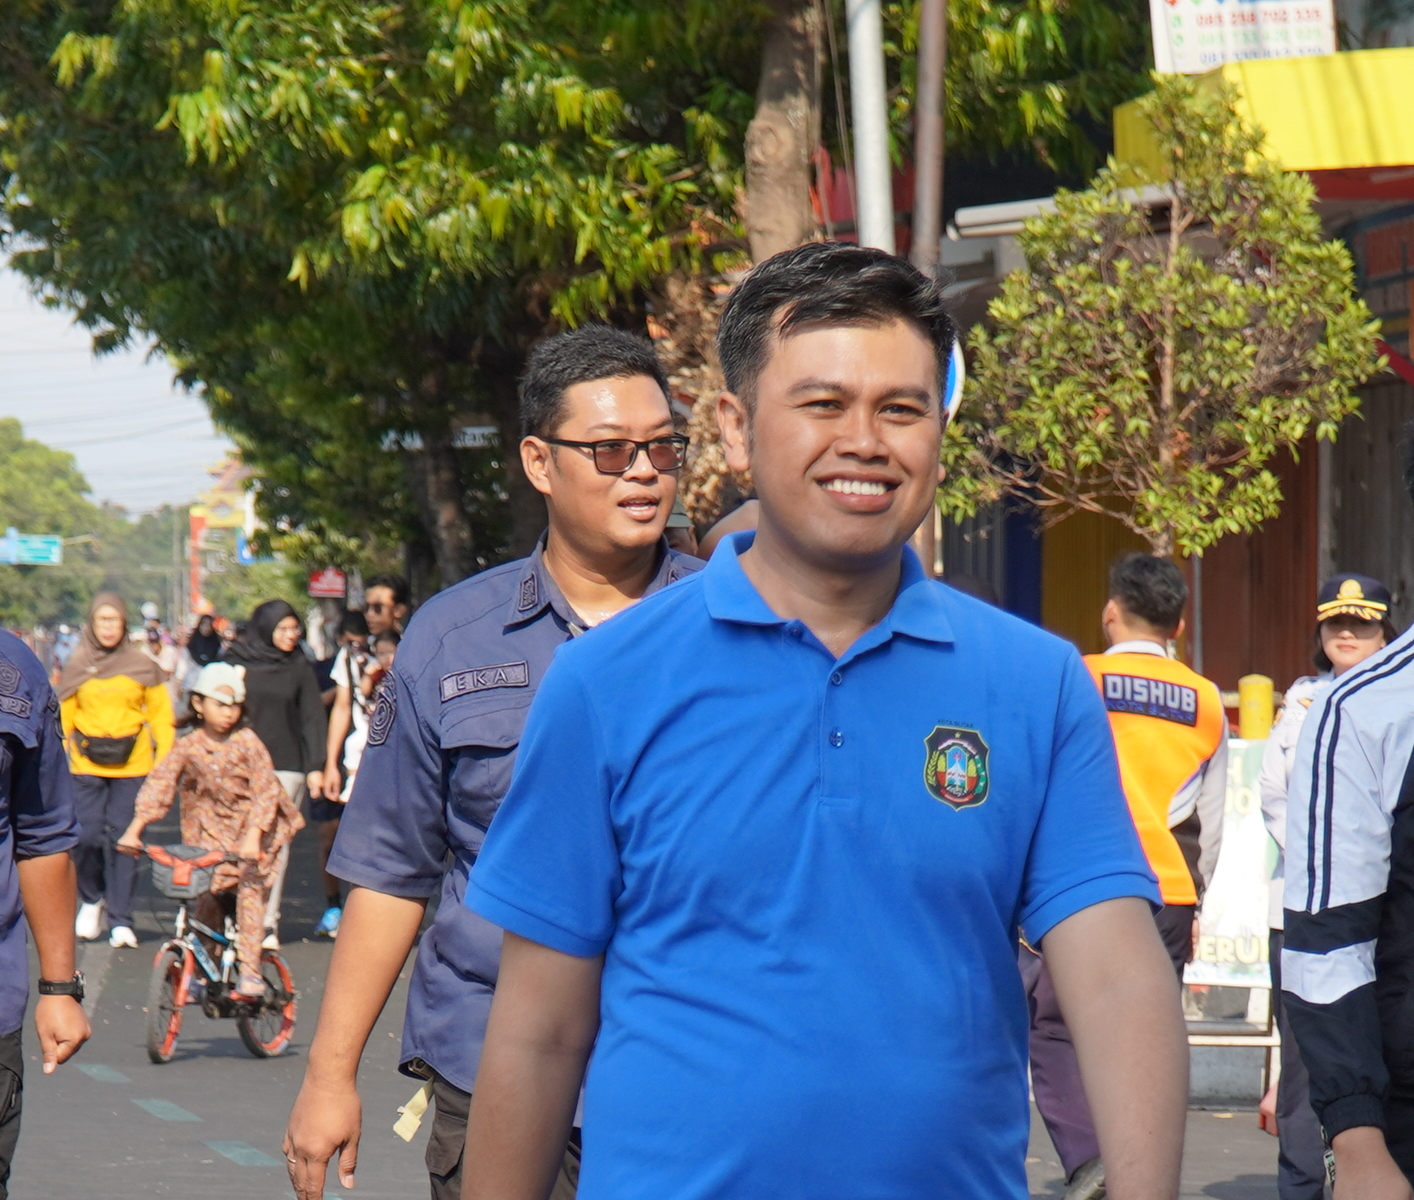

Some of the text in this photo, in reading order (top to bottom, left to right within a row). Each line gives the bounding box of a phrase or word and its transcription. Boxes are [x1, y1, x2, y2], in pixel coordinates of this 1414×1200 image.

[455, 670, 508, 691] EKA
[1104, 674, 1196, 713] DISHUB
[1194, 935, 1270, 965] ERU
